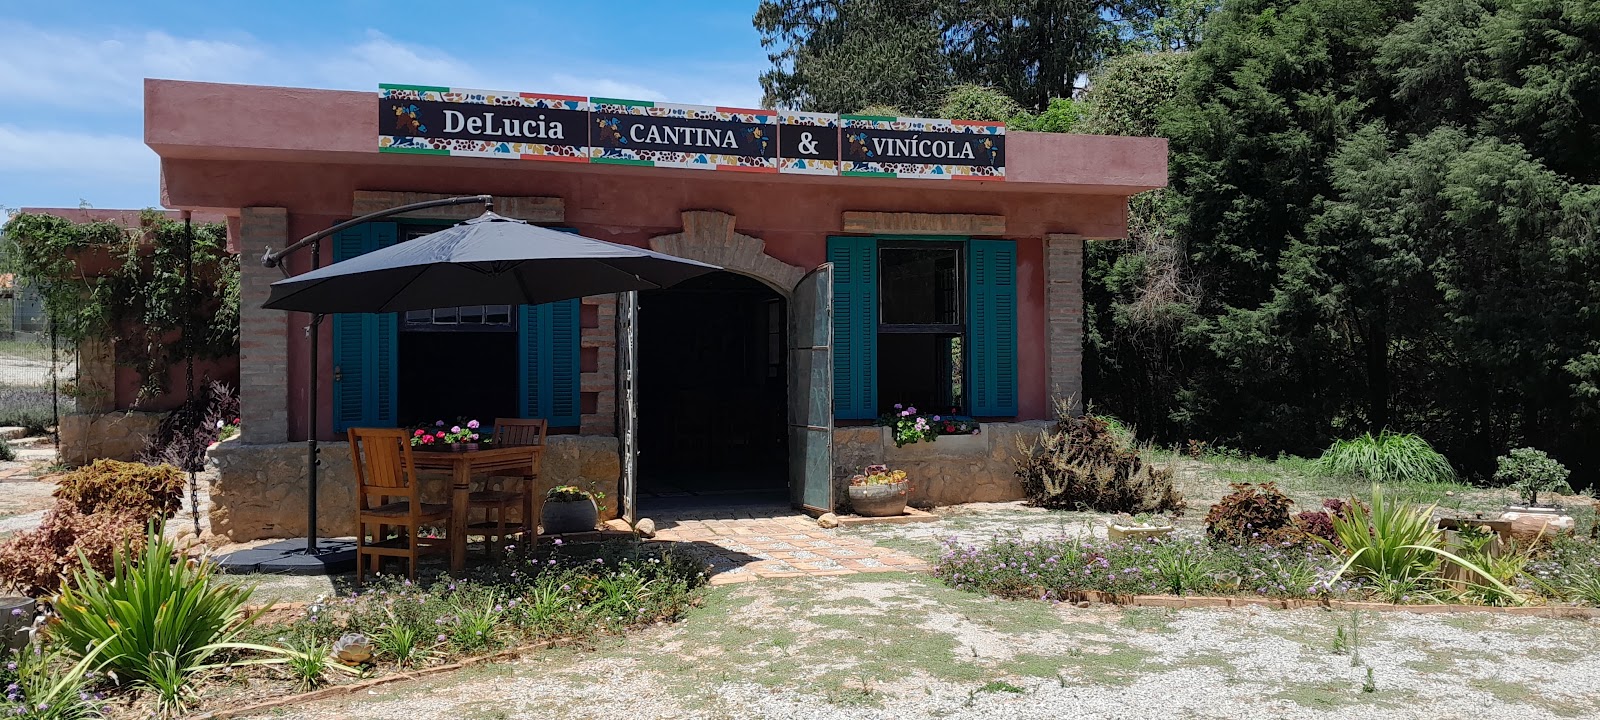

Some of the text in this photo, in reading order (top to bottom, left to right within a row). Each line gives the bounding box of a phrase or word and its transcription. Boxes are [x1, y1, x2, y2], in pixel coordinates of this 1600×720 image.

[443, 109, 975, 160] DeLucia CANTINA & VINÍCOLA
